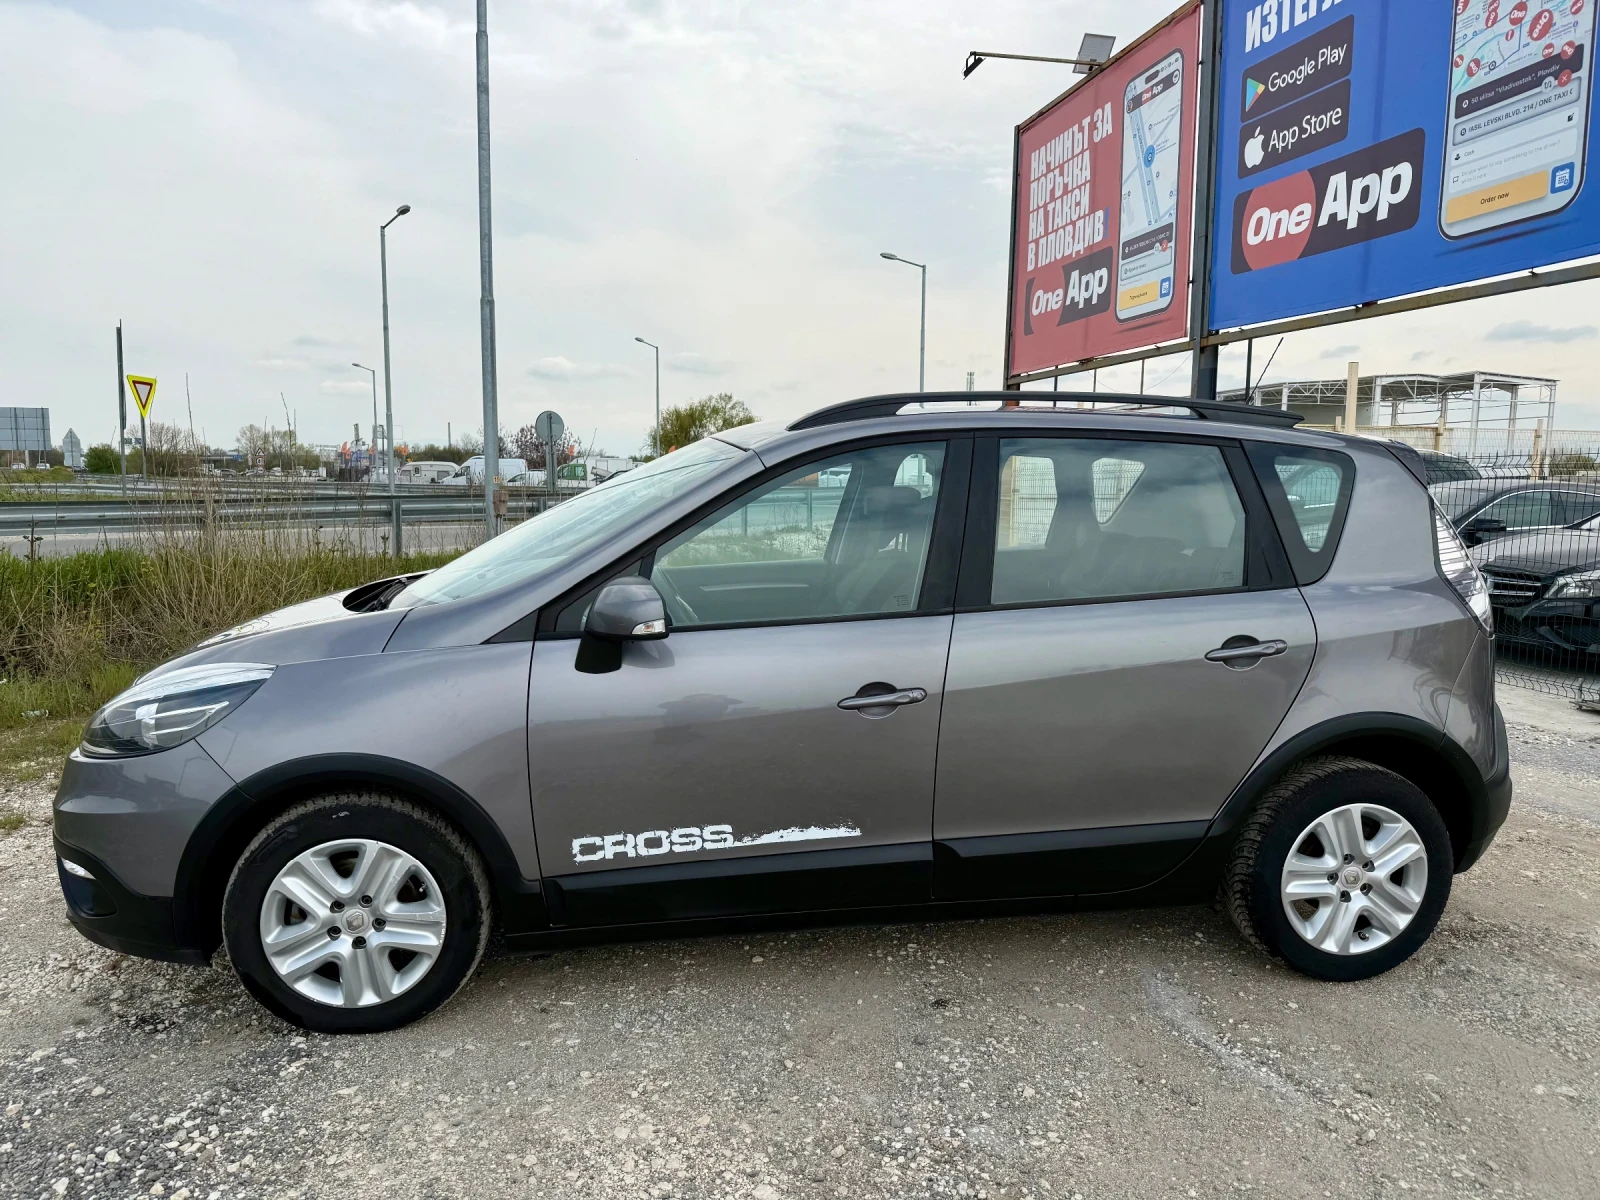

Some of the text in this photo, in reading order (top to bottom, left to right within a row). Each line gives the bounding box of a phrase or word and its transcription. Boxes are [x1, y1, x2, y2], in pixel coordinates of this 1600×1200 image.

[1533, 12, 1549, 37] One
[1268, 43, 1347, 92] Google Play
[1480, 91, 1495, 101] ulitsa
[1537, 64, 1560, 77] Plovdiv
[1268, 107, 1342, 154] App Store
[1483, 114, 1504, 127] LEVSKI
[1504, 108, 1521, 120] BLVD.
[1523, 103, 1534, 113] 214
[1538, 96, 1552, 107] ONE
[1553, 90, 1569, 101] TAXI
[1031, 115, 1091, 180] НАЧИНЪТ
[1093, 102, 1112, 143] ЗА
[1030, 149, 1091, 212] ПОРЪЧКА
[1246, 161, 1413, 246] One App
[1480, 192, 1509, 205] Order now
[1028, 182, 1090, 242] НА ТАКСИ
[1027, 242, 1036, 272] В
[1031, 266, 1109, 316] One App
[571, 824, 734, 865] CROSS
